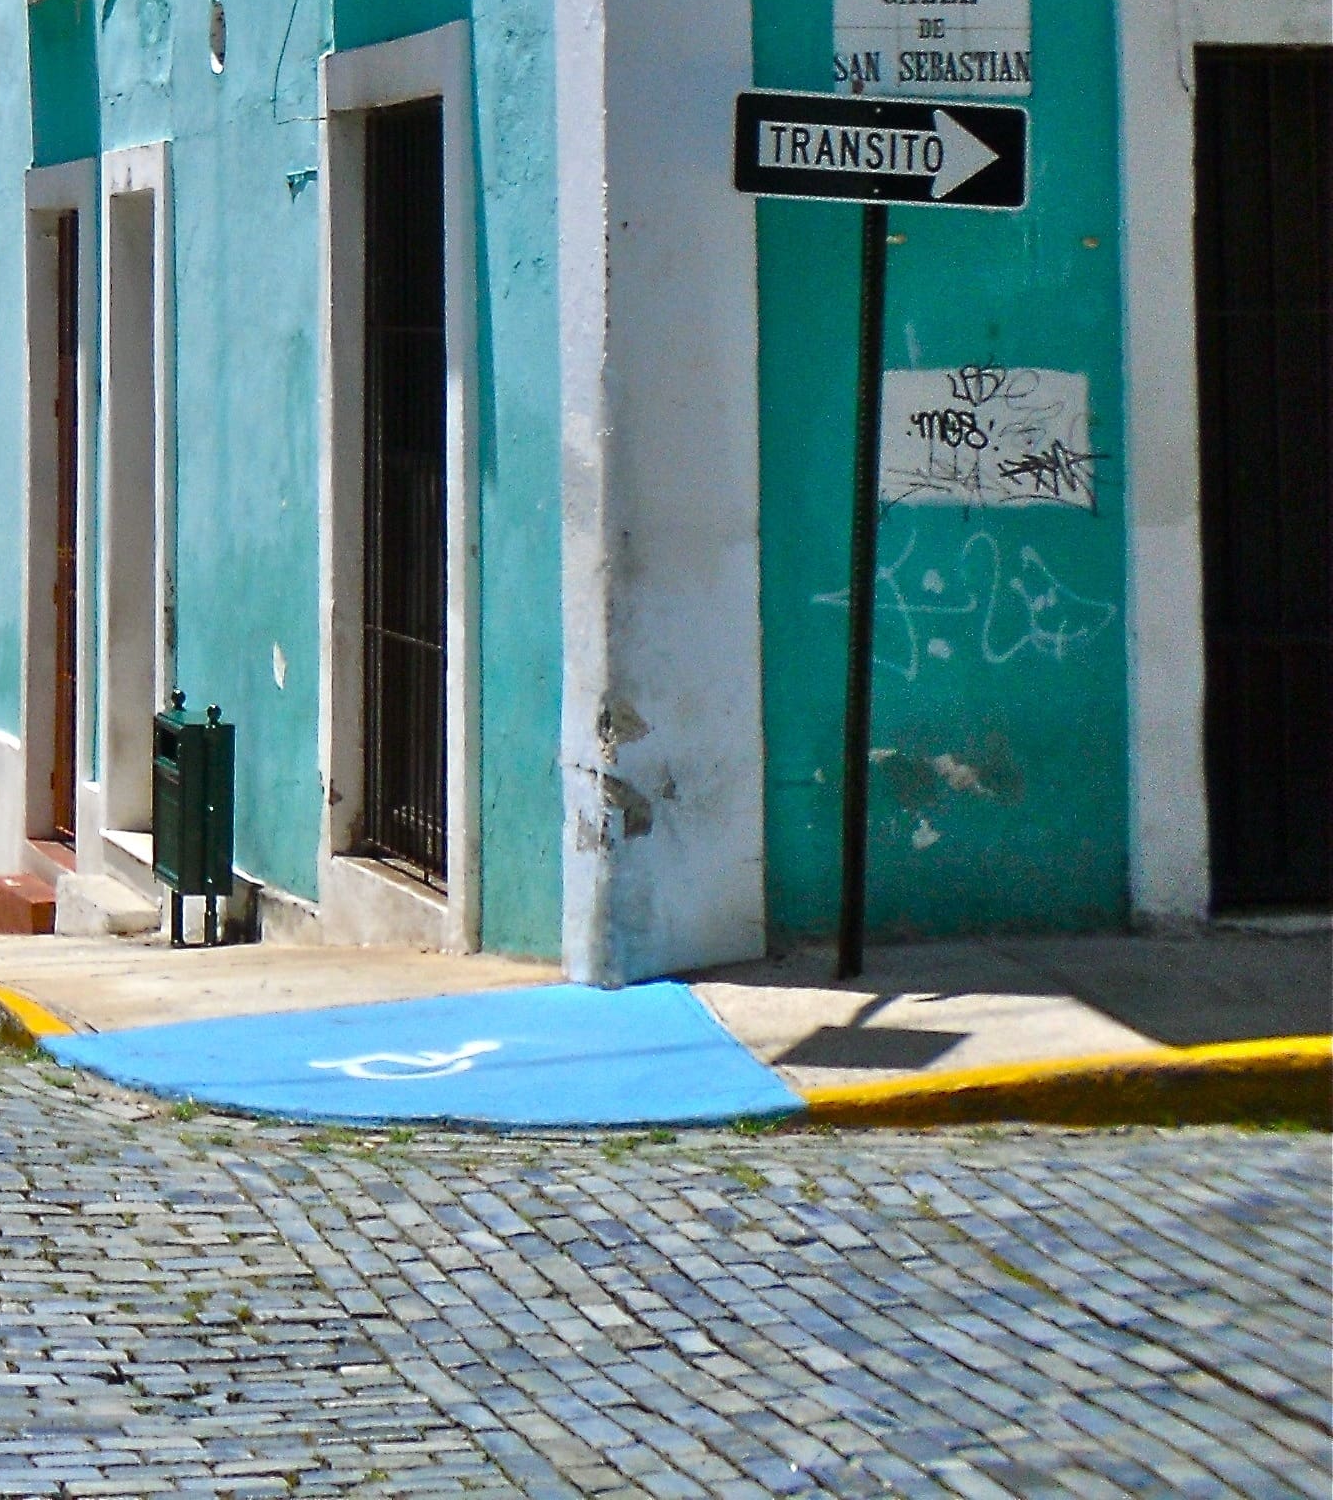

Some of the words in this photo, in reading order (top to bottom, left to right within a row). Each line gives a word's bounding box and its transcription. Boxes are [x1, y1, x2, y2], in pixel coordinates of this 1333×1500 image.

[918, 18, 946, 40] DE
[833, 51, 881, 83] SAN
[898, 50, 1032, 83] SEBASTIAN
[769, 125, 945, 174] TRANSITO
